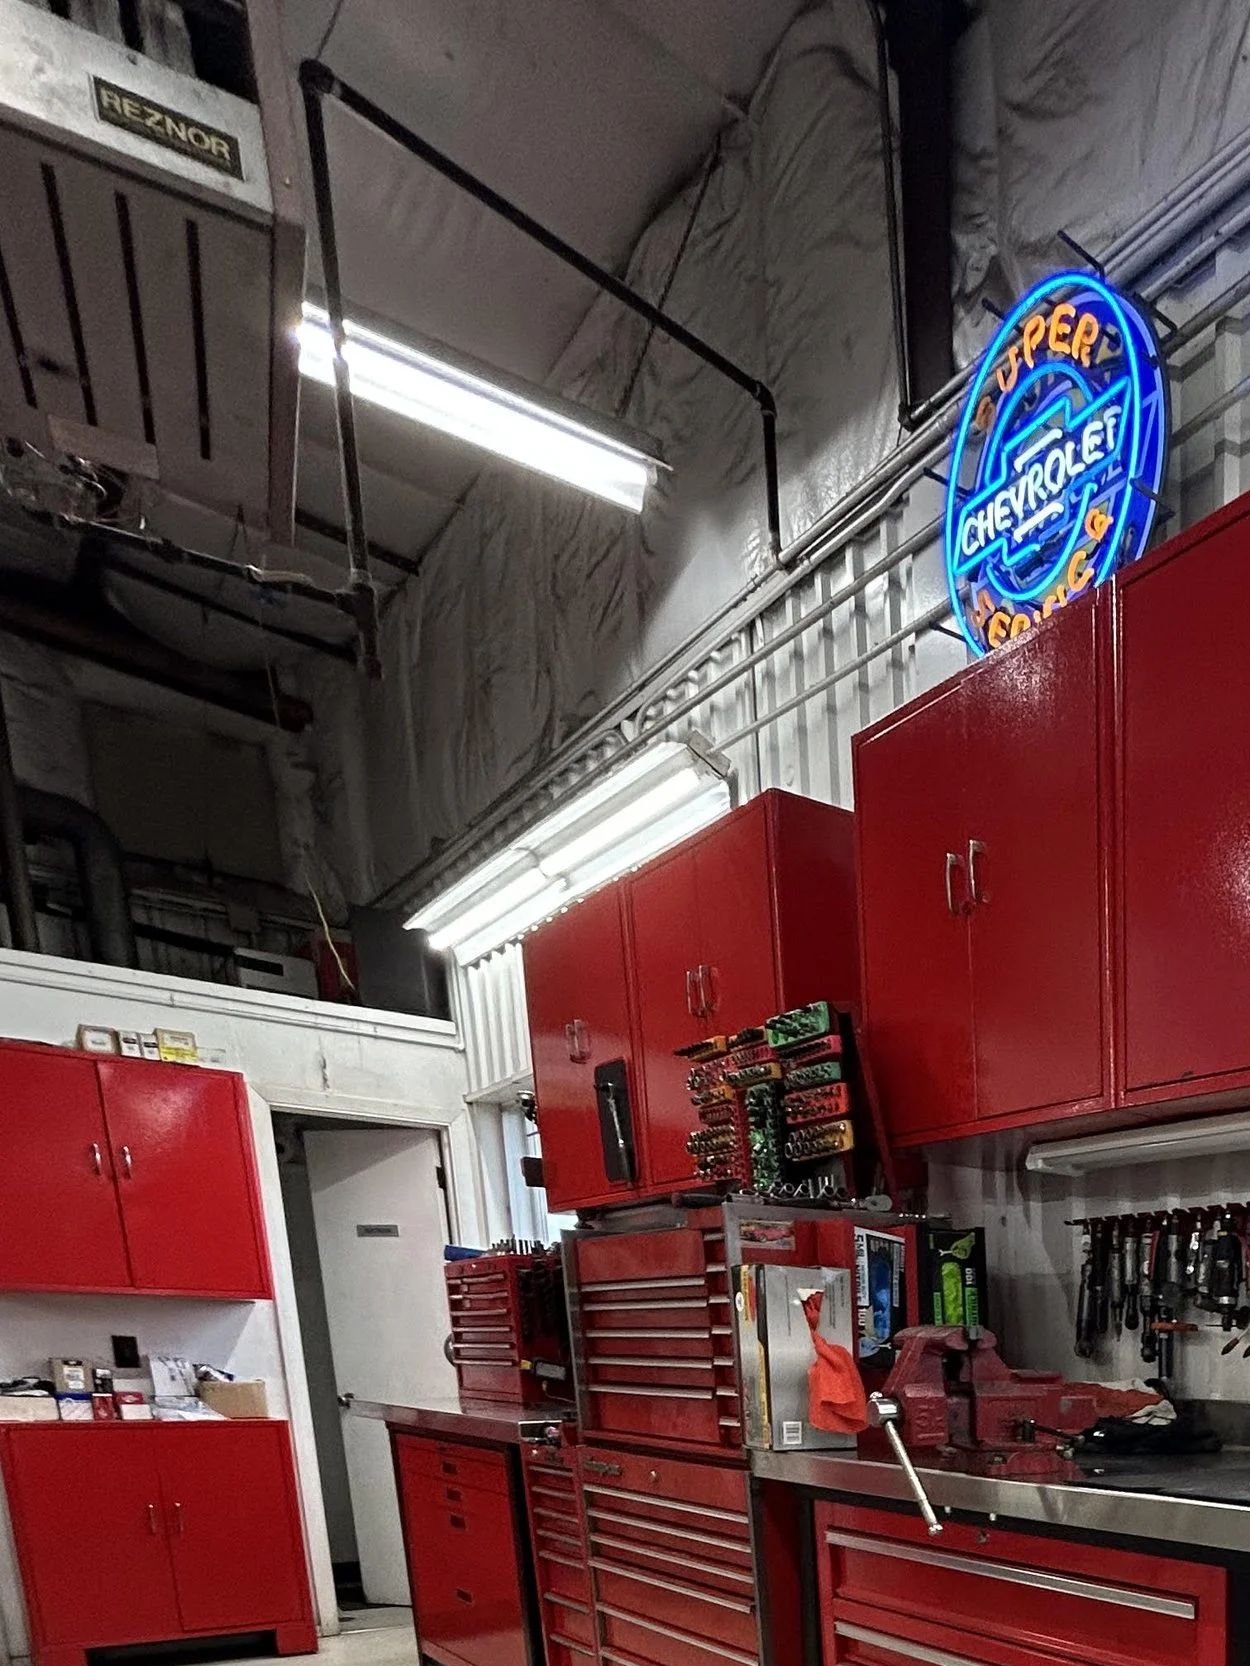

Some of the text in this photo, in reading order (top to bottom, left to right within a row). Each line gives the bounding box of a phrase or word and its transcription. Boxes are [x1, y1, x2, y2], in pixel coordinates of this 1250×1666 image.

[101, 87, 231, 161] REZNOR
[975, 303, 1099, 431] SUPER
[962, 405, 1122, 556] CHEVROLET
